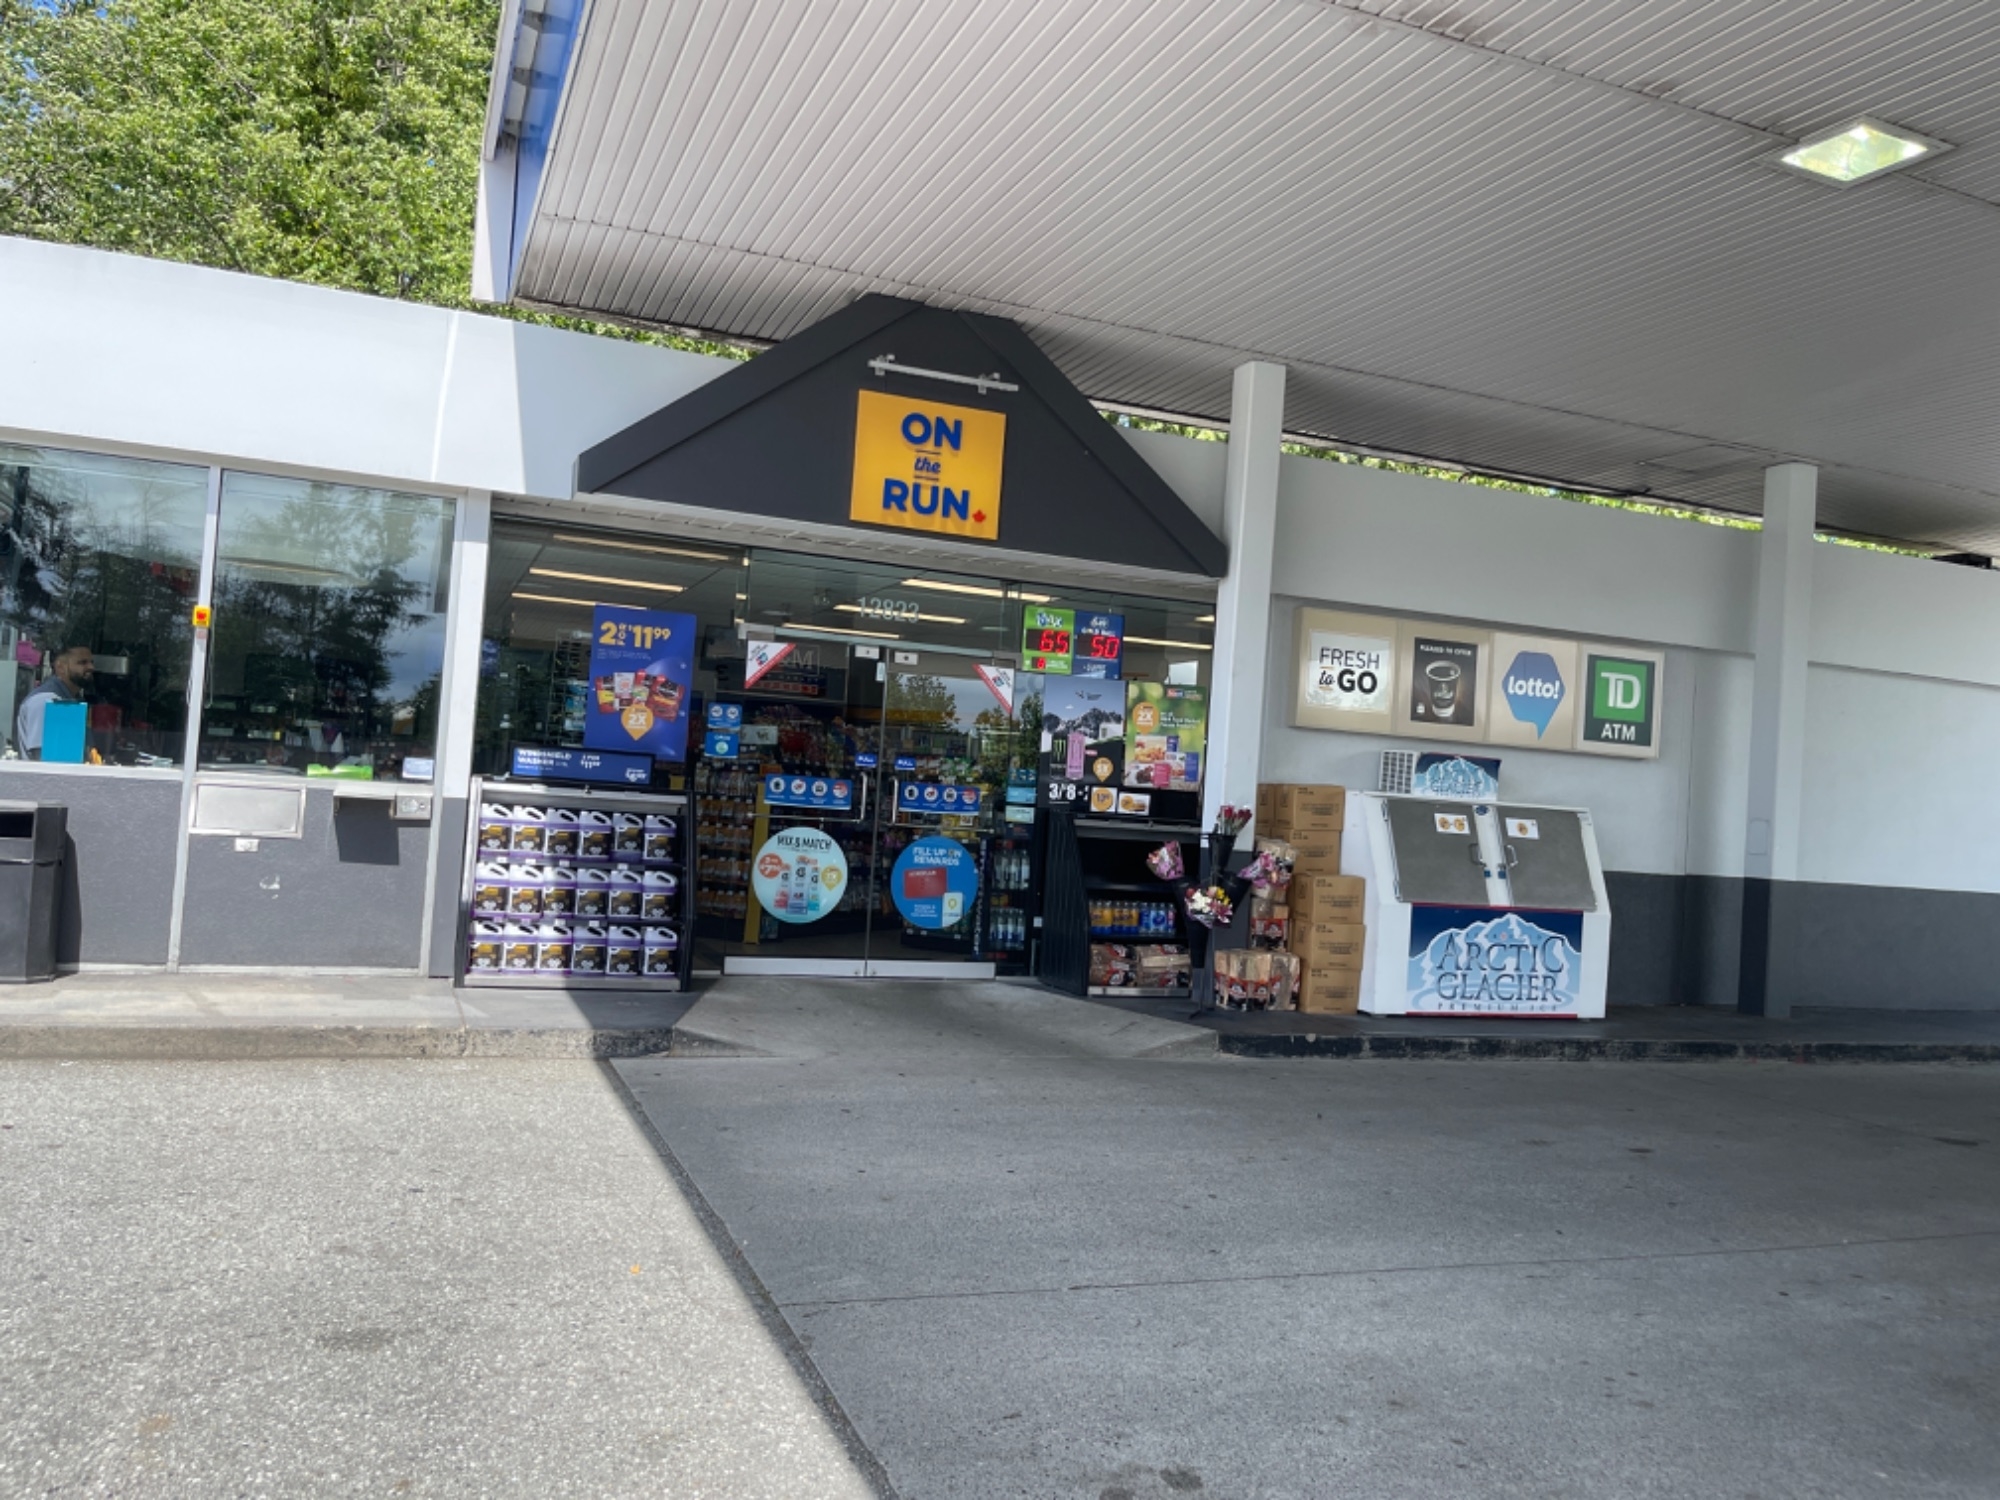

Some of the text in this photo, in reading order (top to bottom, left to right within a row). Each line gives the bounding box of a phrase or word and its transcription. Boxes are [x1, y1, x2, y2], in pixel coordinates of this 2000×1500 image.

[902, 413, 962, 451] ON
[914, 457, 941, 474] the
[882, 478, 970, 520] RUN
[857, 597, 919, 623] 12823
[1040, 629, 1070, 655] 65
[1091, 635, 1119, 659] 50
[1319, 647, 1380, 669] FRESH
[1319, 669, 1378, 694] to GO
[1601, 672, 1642, 709] TD
[1601, 722, 1636, 741] ATM
[803, 837, 832, 850] MATCH
[1436, 933, 1566, 974] ARCTIC
[1438, 972, 1562, 1002] GLACIER
[1438, 1002, 1519, 1012] PREMIUM
